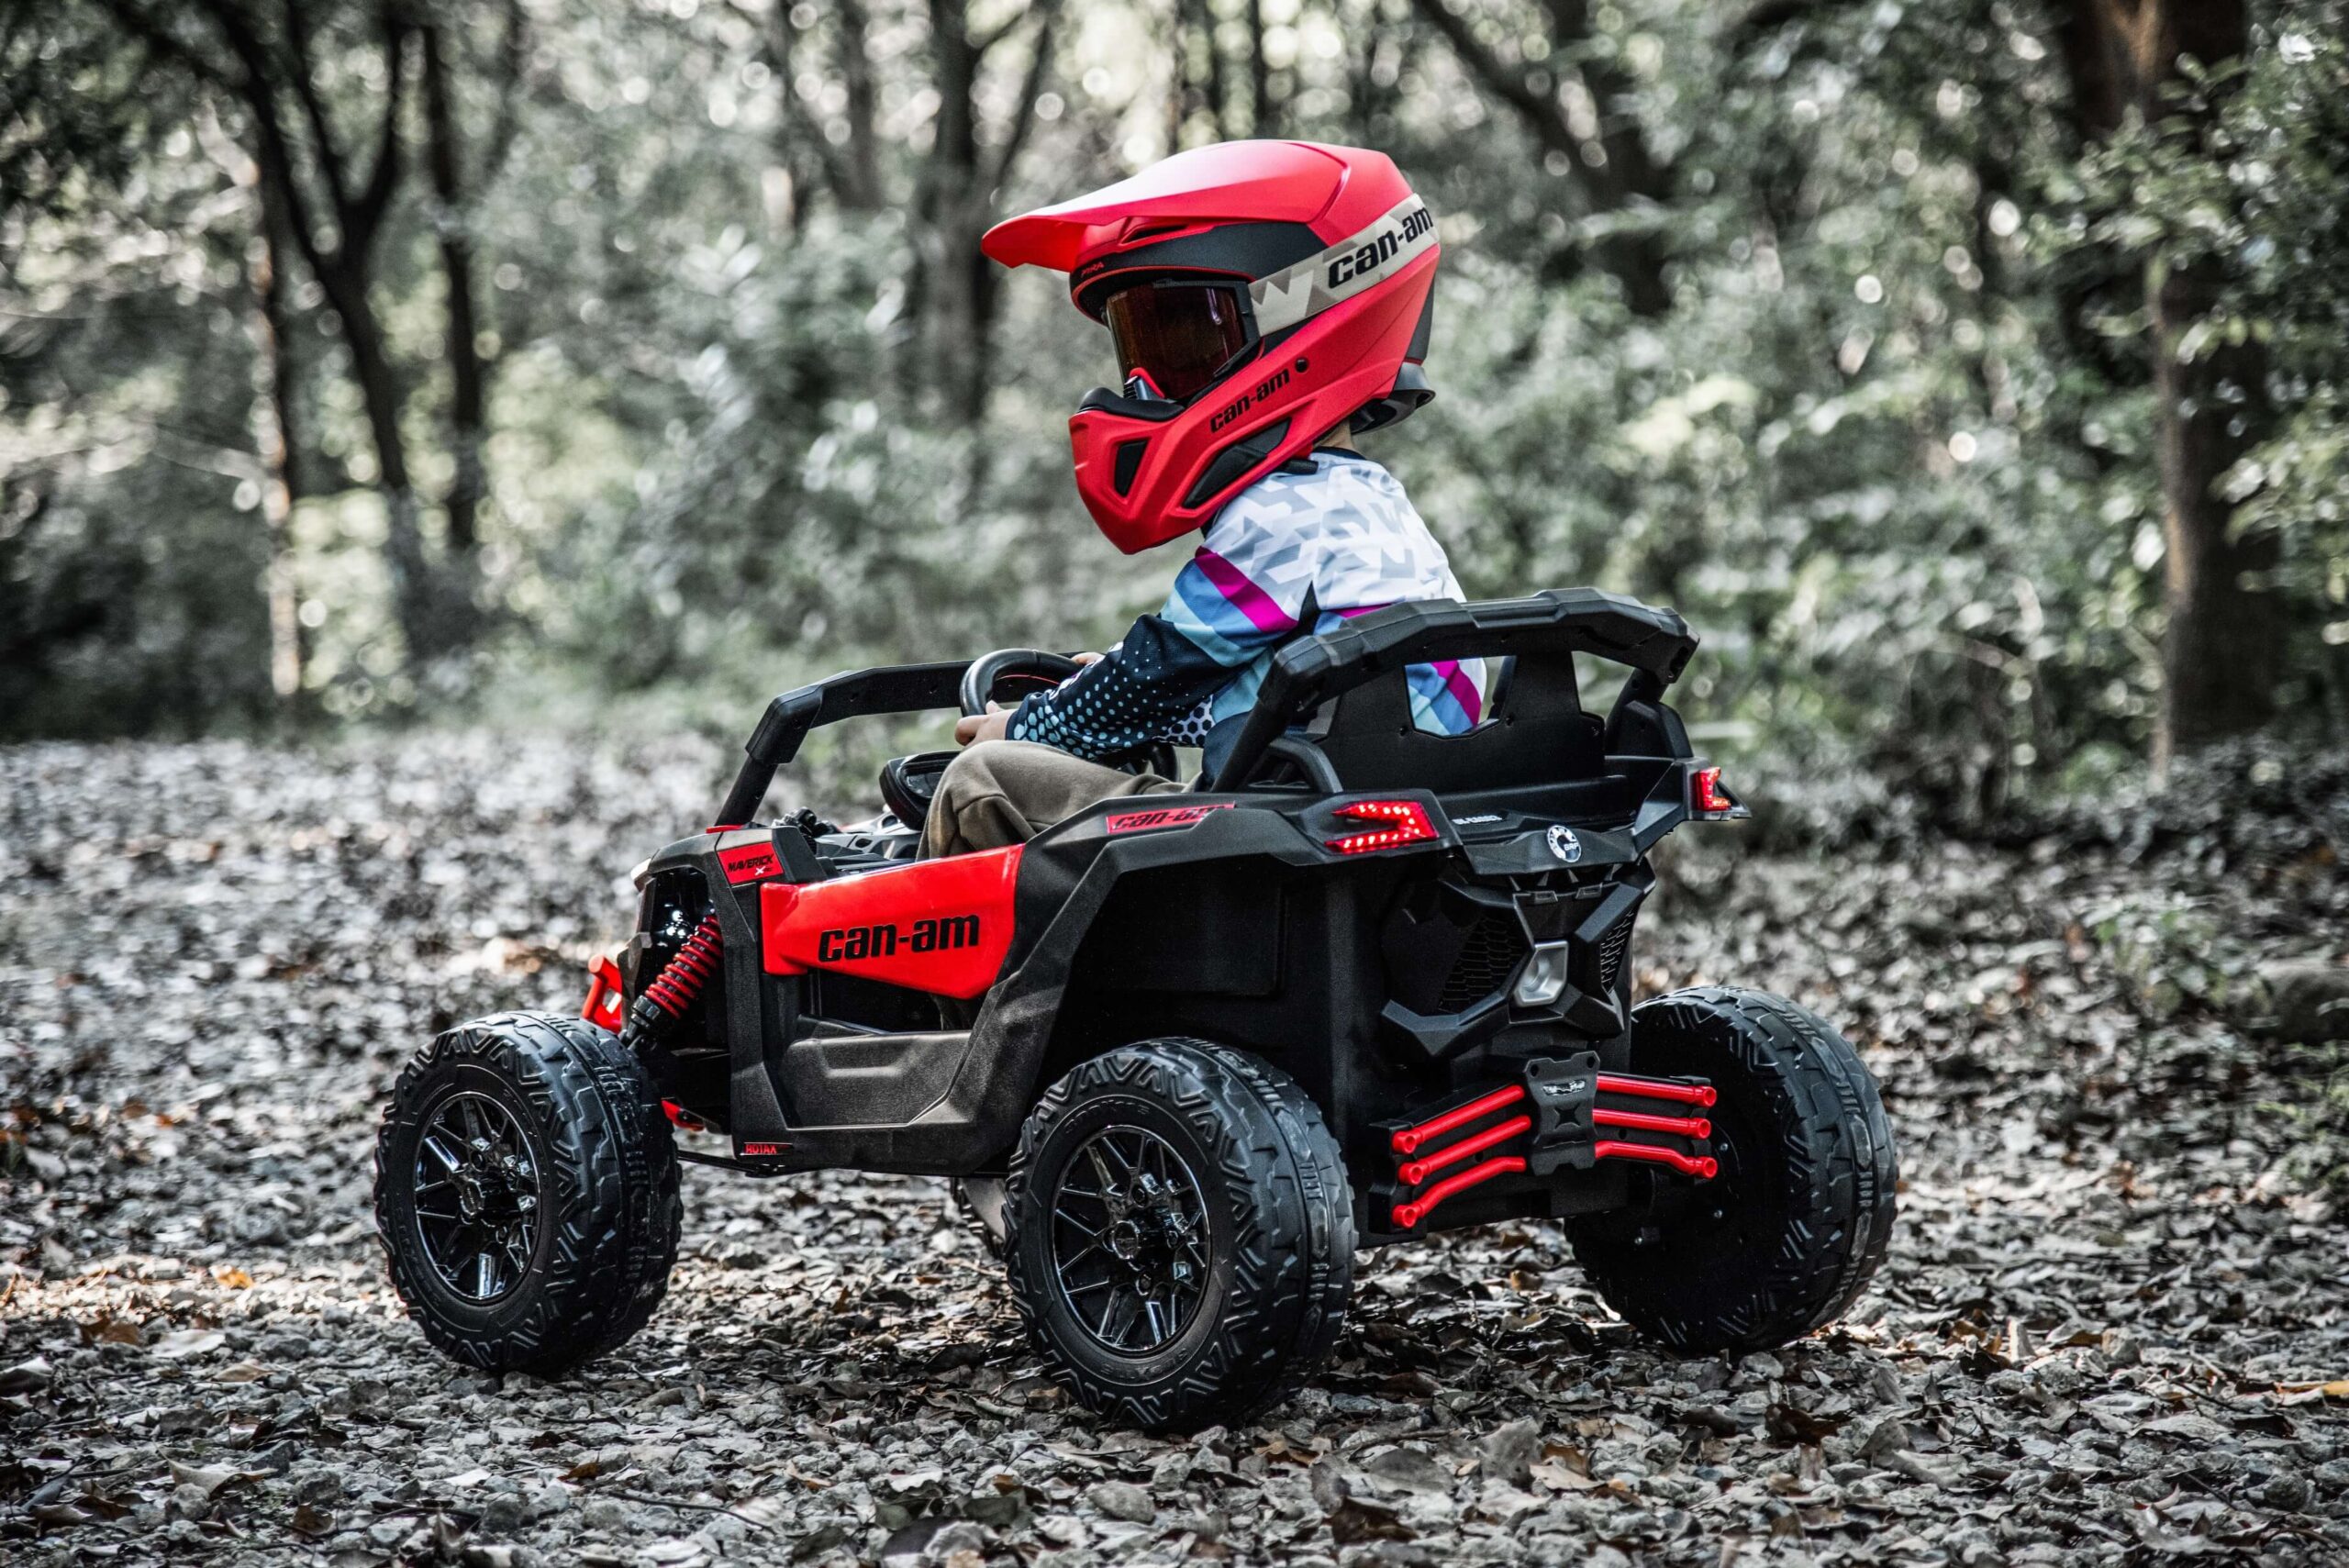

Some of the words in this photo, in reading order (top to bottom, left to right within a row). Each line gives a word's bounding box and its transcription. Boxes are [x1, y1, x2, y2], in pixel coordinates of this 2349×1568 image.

[1329, 207, 1433, 289] can-am
[1209, 368, 1289, 433] can-am
[728, 854, 774, 873] MAVERICK
[818, 914, 980, 962] can-am
